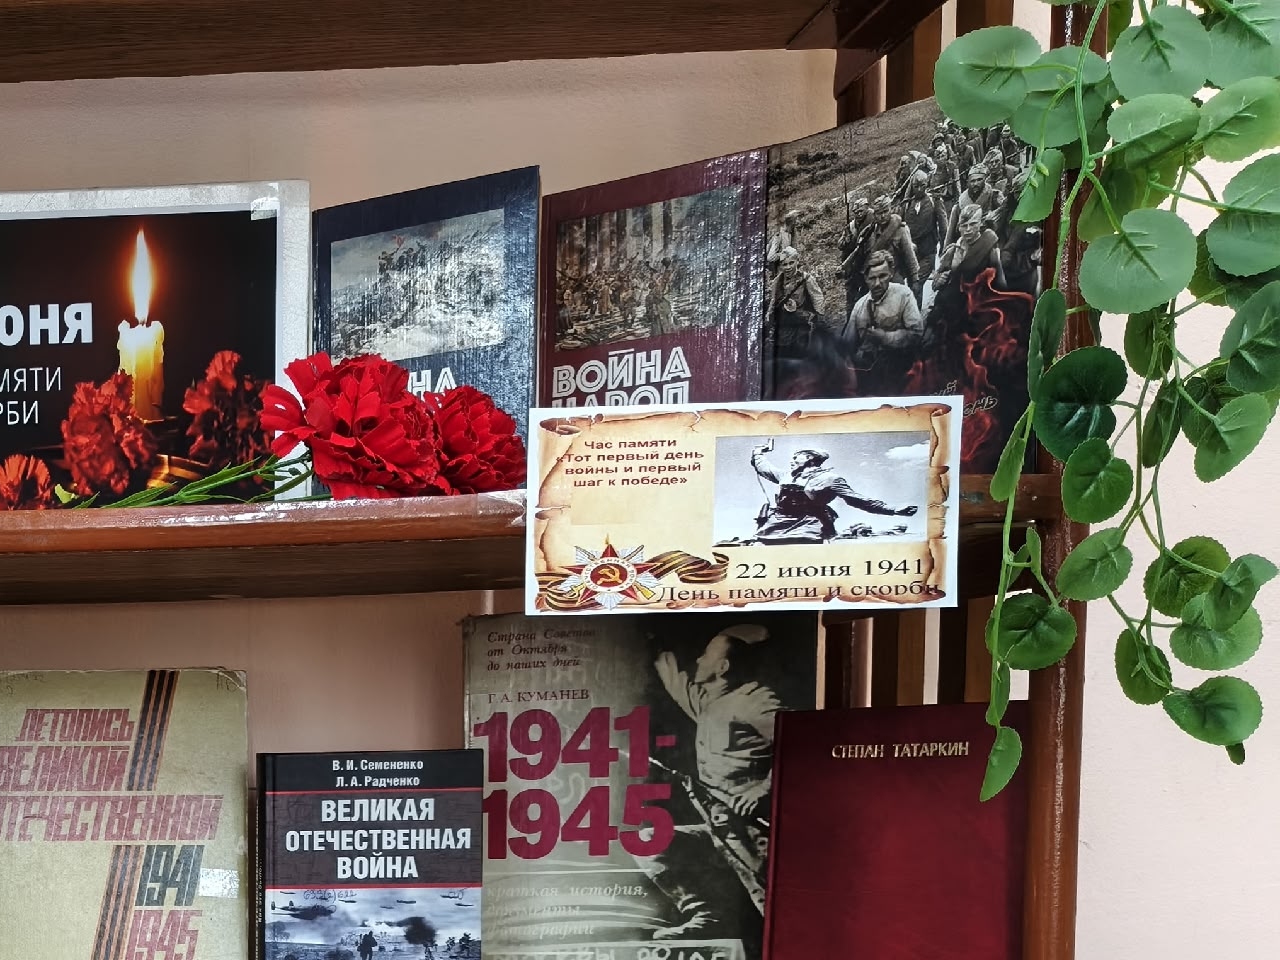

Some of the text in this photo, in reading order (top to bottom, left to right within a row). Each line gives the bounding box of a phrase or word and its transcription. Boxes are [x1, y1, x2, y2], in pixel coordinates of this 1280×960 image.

[552, 345, 692, 398] ВОЙНА
[584, 439, 677, 451] Час памяти
[556, 450, 705, 464] «Тот первый день
[564, 461, 701, 476] войны первый
[573, 475, 688, 488] шаг победе»
[735, 558, 926, 580] 22 июня 1941
[656, 583, 820, 604] День памяти
[517, 688, 590, 703] КУМАНЕВ
[14, 708, 135, 742] ЛЕТОПИСЬ
[473, 706, 676, 783] 1941-
[831, 741, 970, 759] СТЕПАН ТАТАРКИН
[360, 756, 424, 772] Семененко
[364, 773, 421, 789] Радченко
[321, 798, 435, 823] ВЕЛИКАЯ
[483, 783, 674, 860] 1945
[285, 826, 472, 852] ОТЕЧЕСТВЕННАЯ
[135, 844, 206, 907] 1941
[336, 853, 419, 880] ВОЙНА
